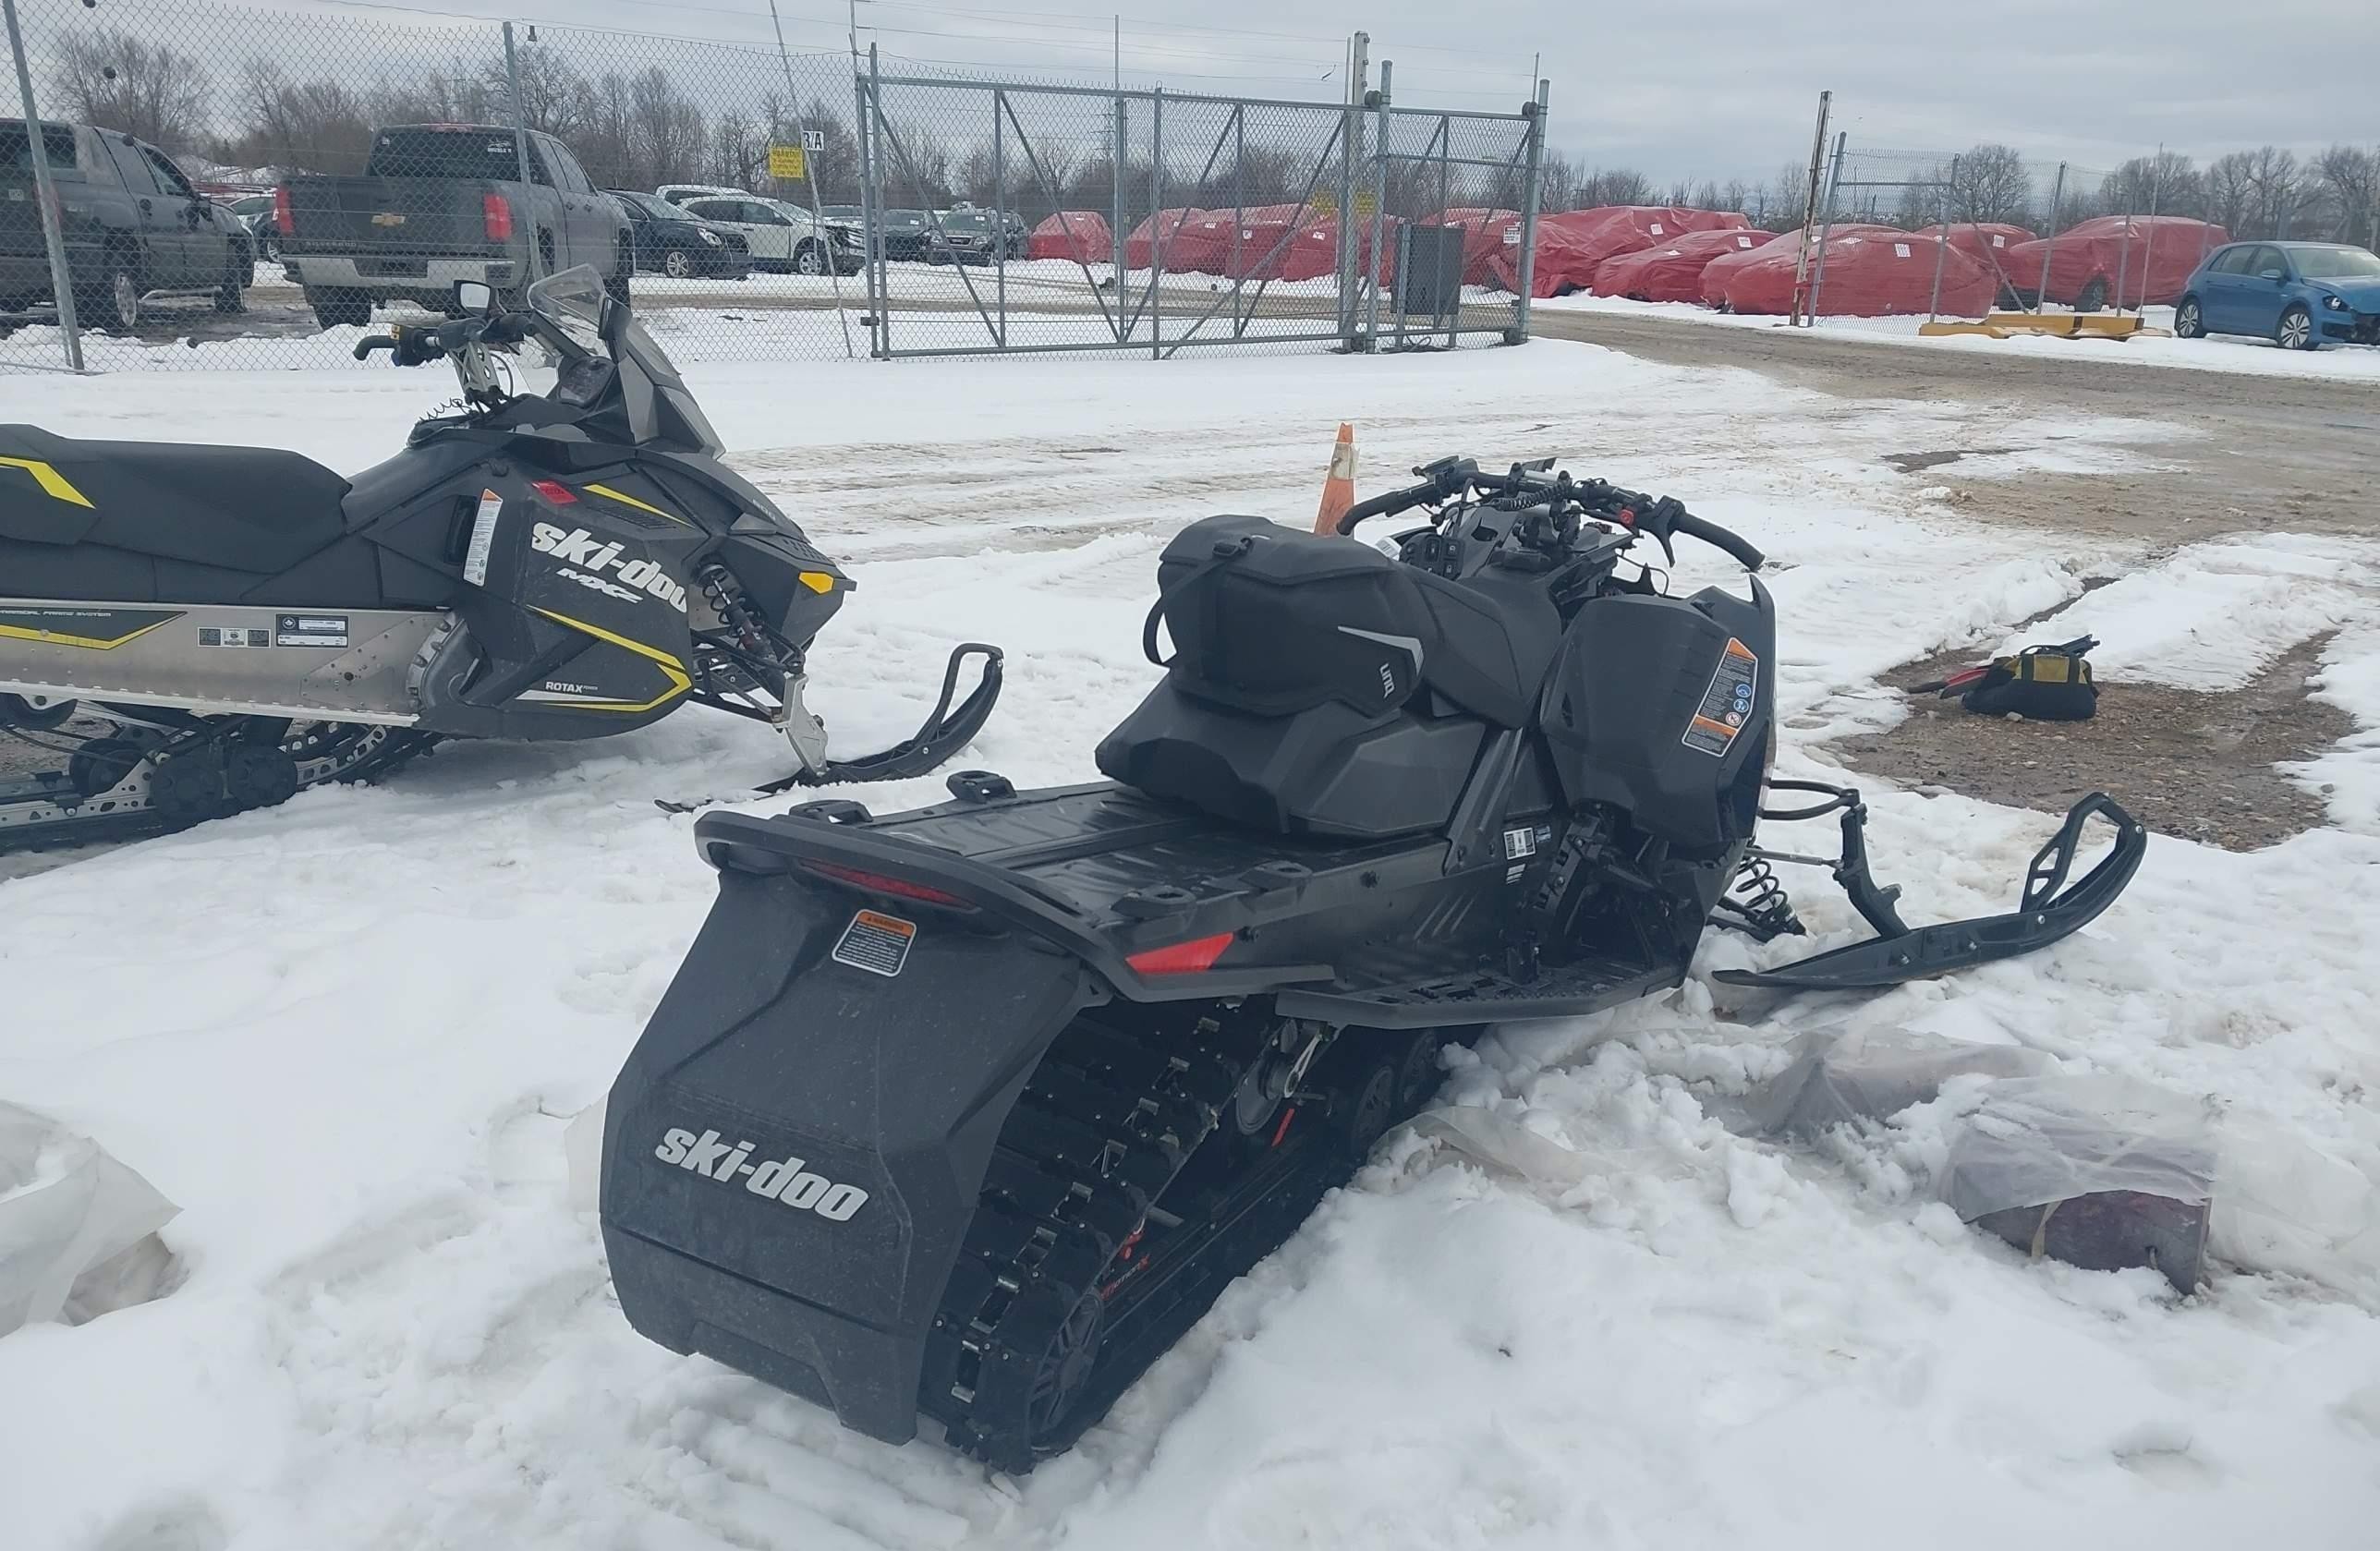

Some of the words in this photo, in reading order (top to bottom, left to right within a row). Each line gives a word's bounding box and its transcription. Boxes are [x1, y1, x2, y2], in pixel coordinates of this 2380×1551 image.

[531, 522, 687, 613] ski-doo
[556, 568, 644, 604] MXZ
[545, 681, 583, 694] ROTAX
[655, 1128, 869, 1221] ski-doo
